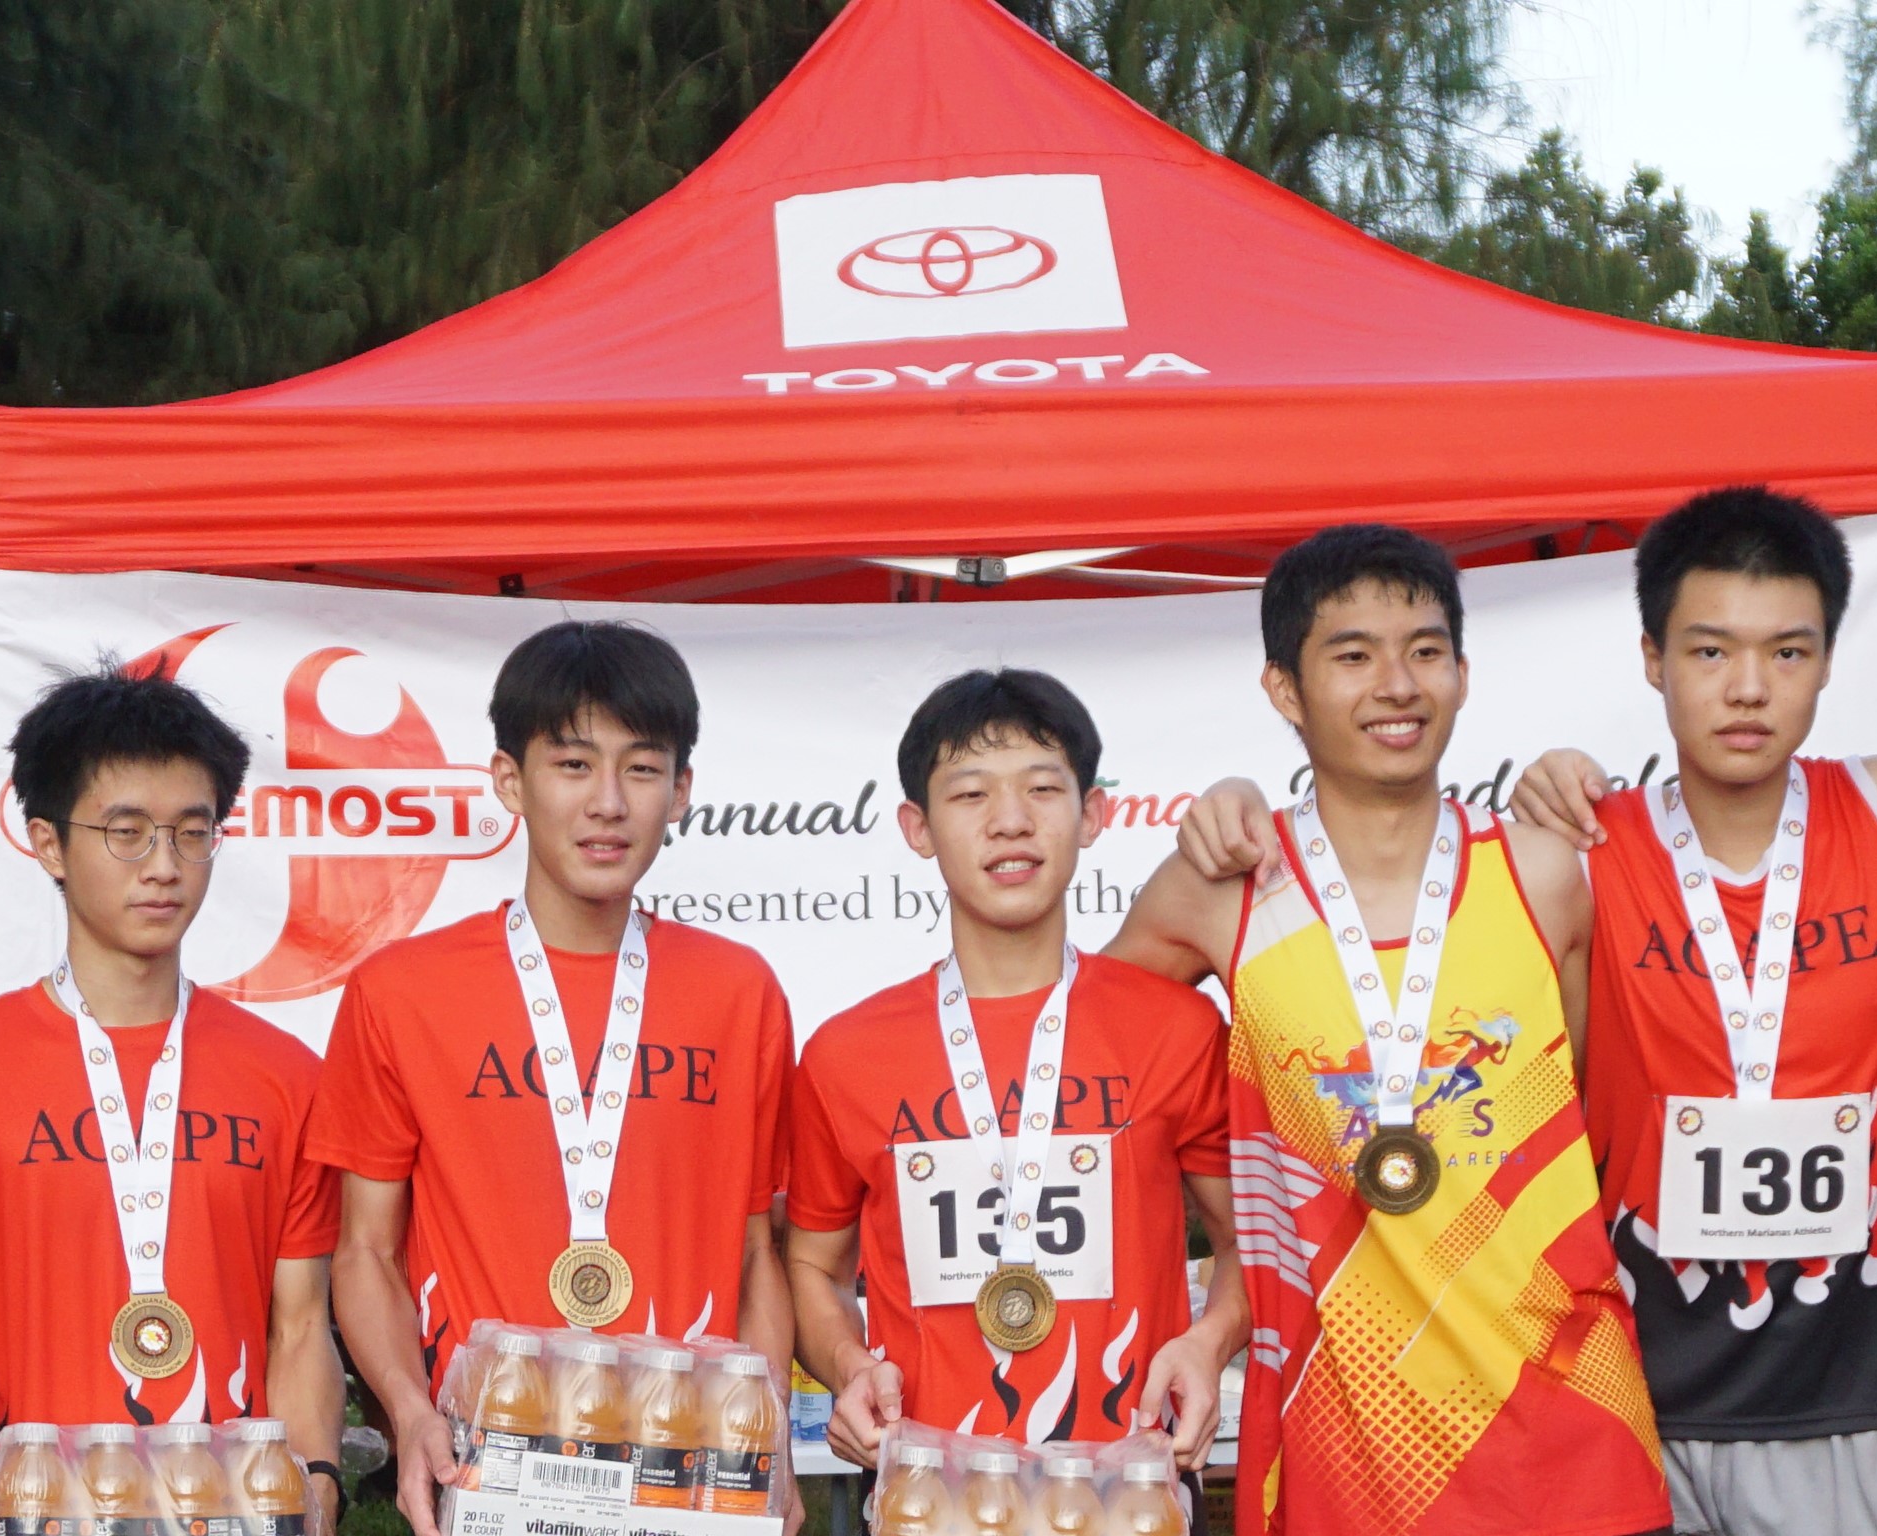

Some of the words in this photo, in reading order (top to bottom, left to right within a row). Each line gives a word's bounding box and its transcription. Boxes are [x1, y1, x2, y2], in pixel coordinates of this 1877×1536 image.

[743, 352, 1210, 394] TOYOTA
[224, 786, 484, 838] EMOST
[661, 779, 879, 846] nnual
[894, 874, 950, 933] by
[19, 1110, 264, 1171] APE
[1694, 1144, 1846, 1216] 136
[929, 1185, 1085, 1258] 135
[1701, 1228, 1745, 1237] Northern
[1794, 1226, 1831, 1235] Athletics
[940, 1272, 981, 1282] Northern
[1038, 1268, 1074, 1277] thletics
[463, 1525, 472, 1534] 12
[475, 1526, 503, 1536] COUNT
[464, 1511, 476, 1522] 20
